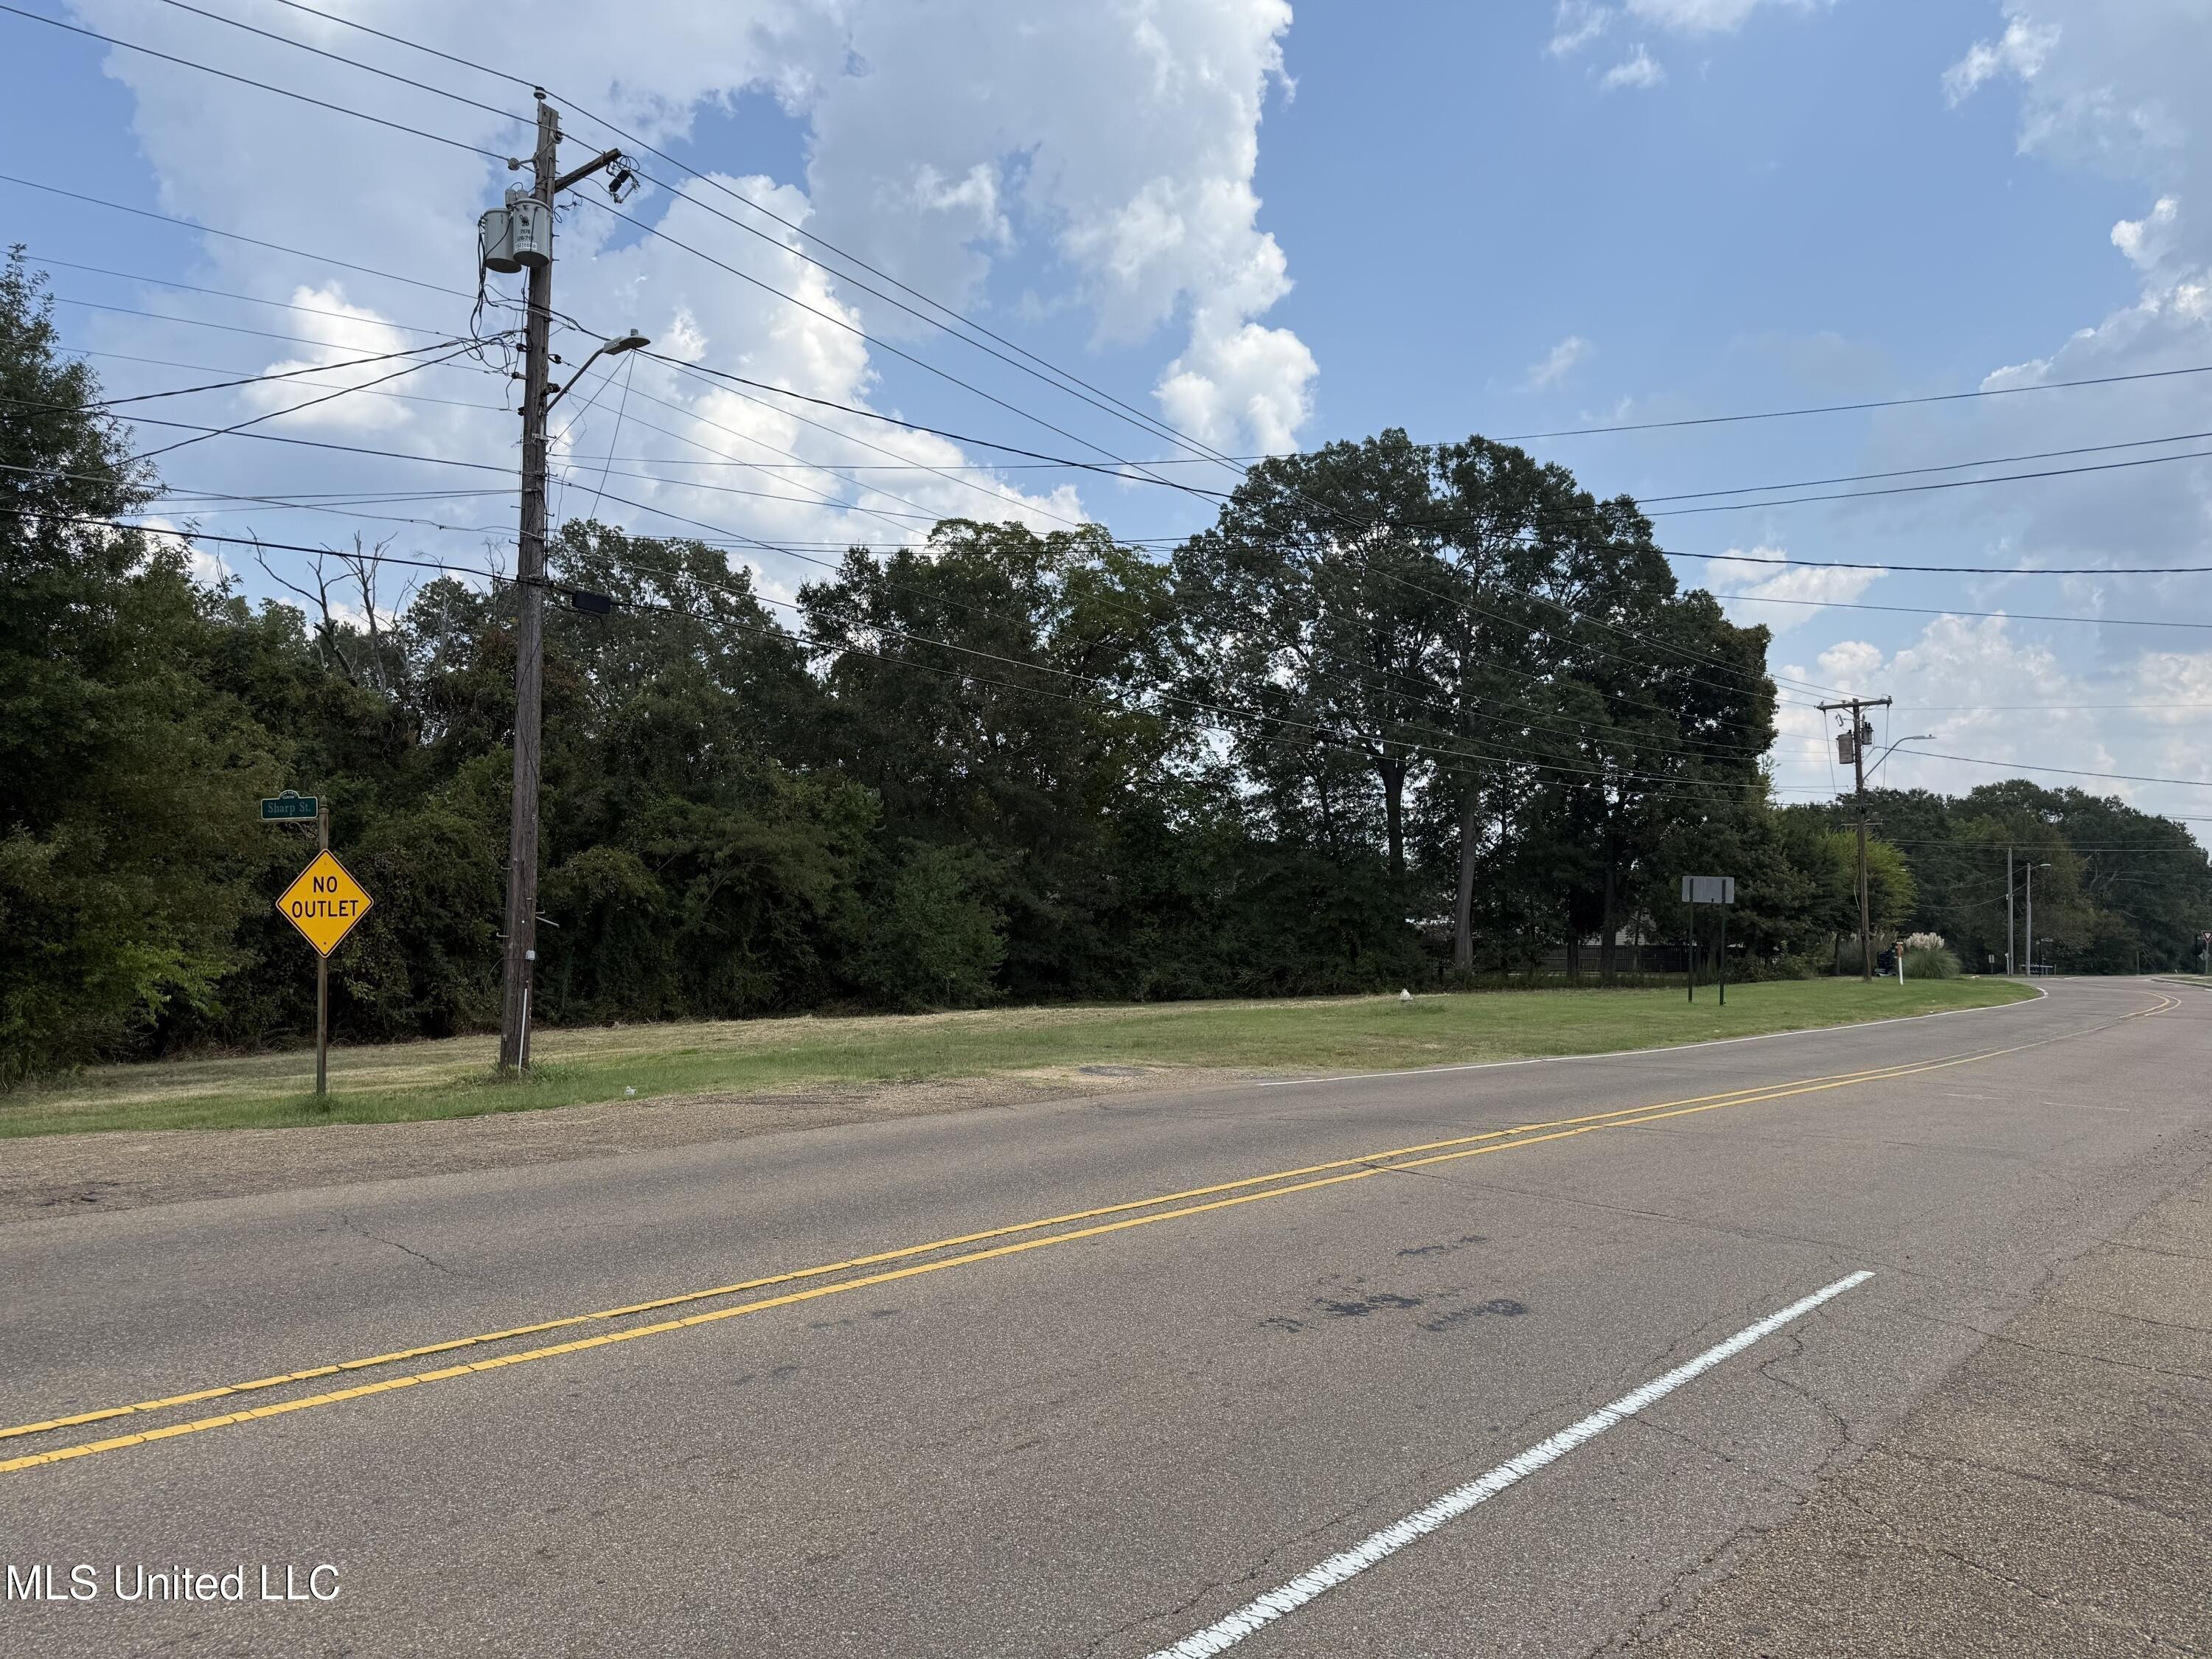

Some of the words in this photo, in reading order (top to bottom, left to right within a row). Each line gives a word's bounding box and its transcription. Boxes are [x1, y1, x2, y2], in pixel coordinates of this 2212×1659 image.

[268, 802, 295, 815] Sharp
[299, 801, 311, 813] St.
[313, 876, 338, 893] NO
[291, 900, 359, 918] OUTLET
